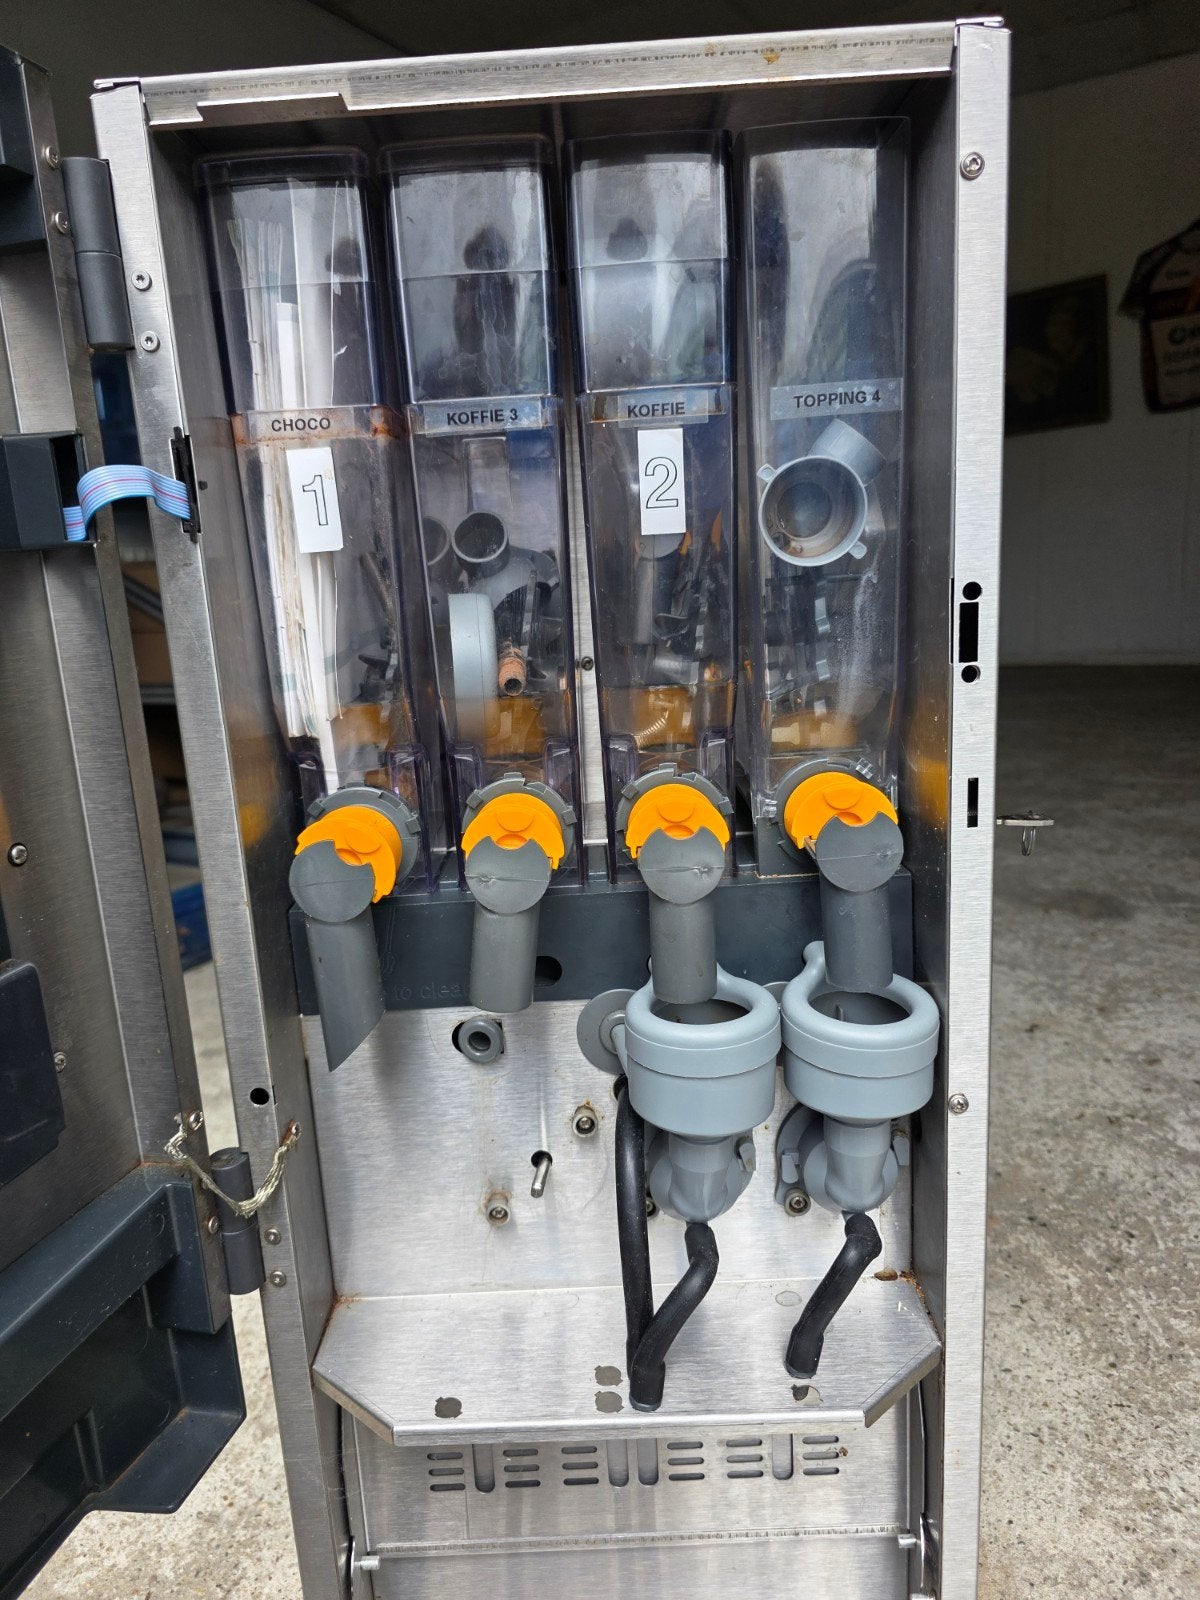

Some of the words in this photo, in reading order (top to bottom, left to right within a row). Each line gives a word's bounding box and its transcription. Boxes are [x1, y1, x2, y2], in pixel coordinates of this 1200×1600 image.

[794, 392, 867, 408] TOPPING
[869, 389, 881, 403] 4
[446, 410, 505, 426] KOFFIE
[509, 408, 518, 421] 3
[627, 402, 686, 417] KOFFIE
[271, 417, 331, 432] CHOCO
[644, 456, 679, 509] 2
[302, 474, 329, 526] 1
[420, 981, 470, 999] clea
